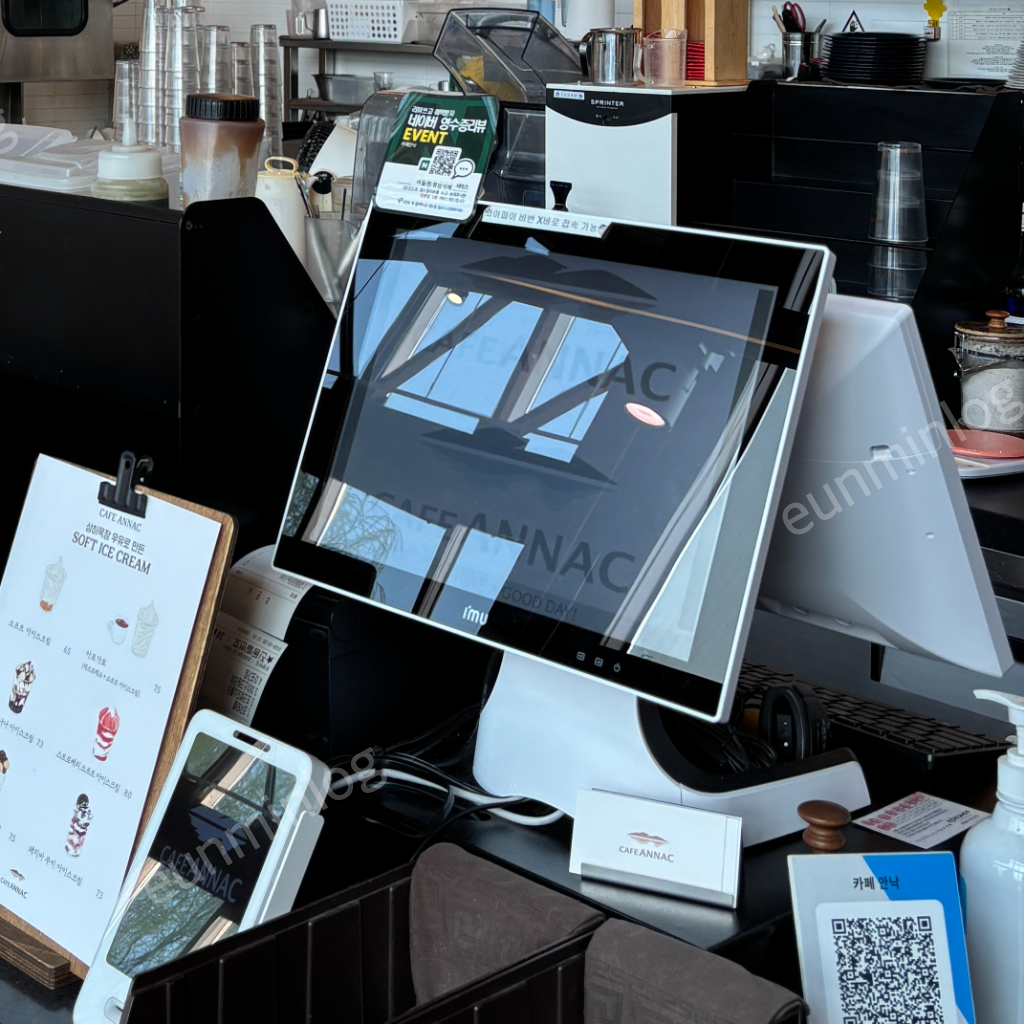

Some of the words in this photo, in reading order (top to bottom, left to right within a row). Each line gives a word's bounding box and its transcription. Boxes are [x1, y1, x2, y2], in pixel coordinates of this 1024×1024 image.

[590, 99, 625, 107] SPRINTER
[406, 114, 438, 128] 네이버
[439, 117, 487, 132] 영수증리뷰
[402, 128, 448, 143] EVENT
[581, 222, 598, 233] 가능
[99, 508, 117, 522] CAFE
[116, 515, 142, 532] ANNAC
[85, 521, 111, 541] 상하목장
[110, 532, 130, 549] 우유로
[130, 540, 145, 555] 만든
[71, 530, 98, 552] SOFT
[97, 541, 115, 559] ICE
[114, 548, 151, 574] CREAM
[8, 617, 25, 633] 소프트
[24, 625, 52, 646] 아이스크림
[8, 722, 34, 744] 아이스크림
[55, 749, 81, 770] 스트로베리
[80, 763, 96, 778] 소프트
[94, 771, 120, 793] 아이스크림
[619, 845, 674, 863] CAFEANNAC
[55, 862, 82, 887] 아이스크림
[853, 876, 876, 890] 카페
[878, 876, 900, 890] 안낙
